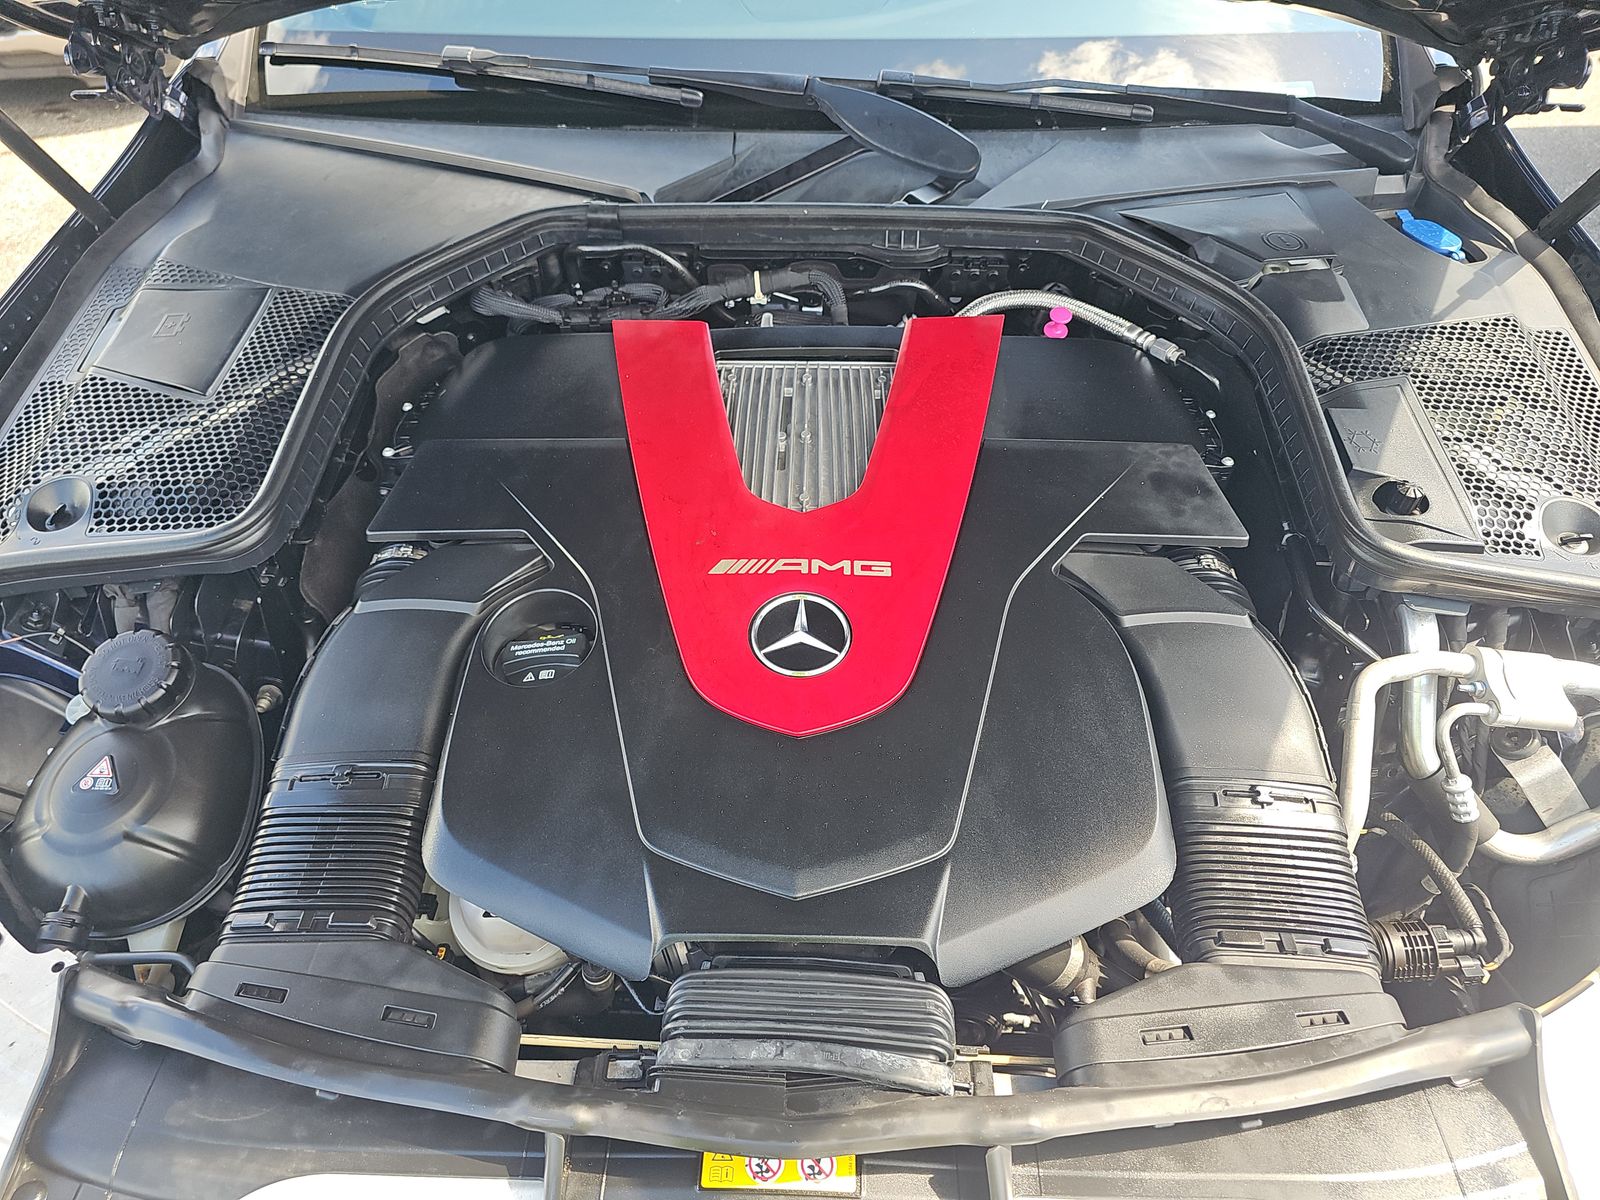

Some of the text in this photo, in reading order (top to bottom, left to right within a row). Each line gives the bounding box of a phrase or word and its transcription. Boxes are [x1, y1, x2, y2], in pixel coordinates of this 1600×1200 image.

[766, 558, 892, 577] AMG
[510, 640, 565, 651] Mercedes-Benz
[515, 645, 566, 656] recommended
